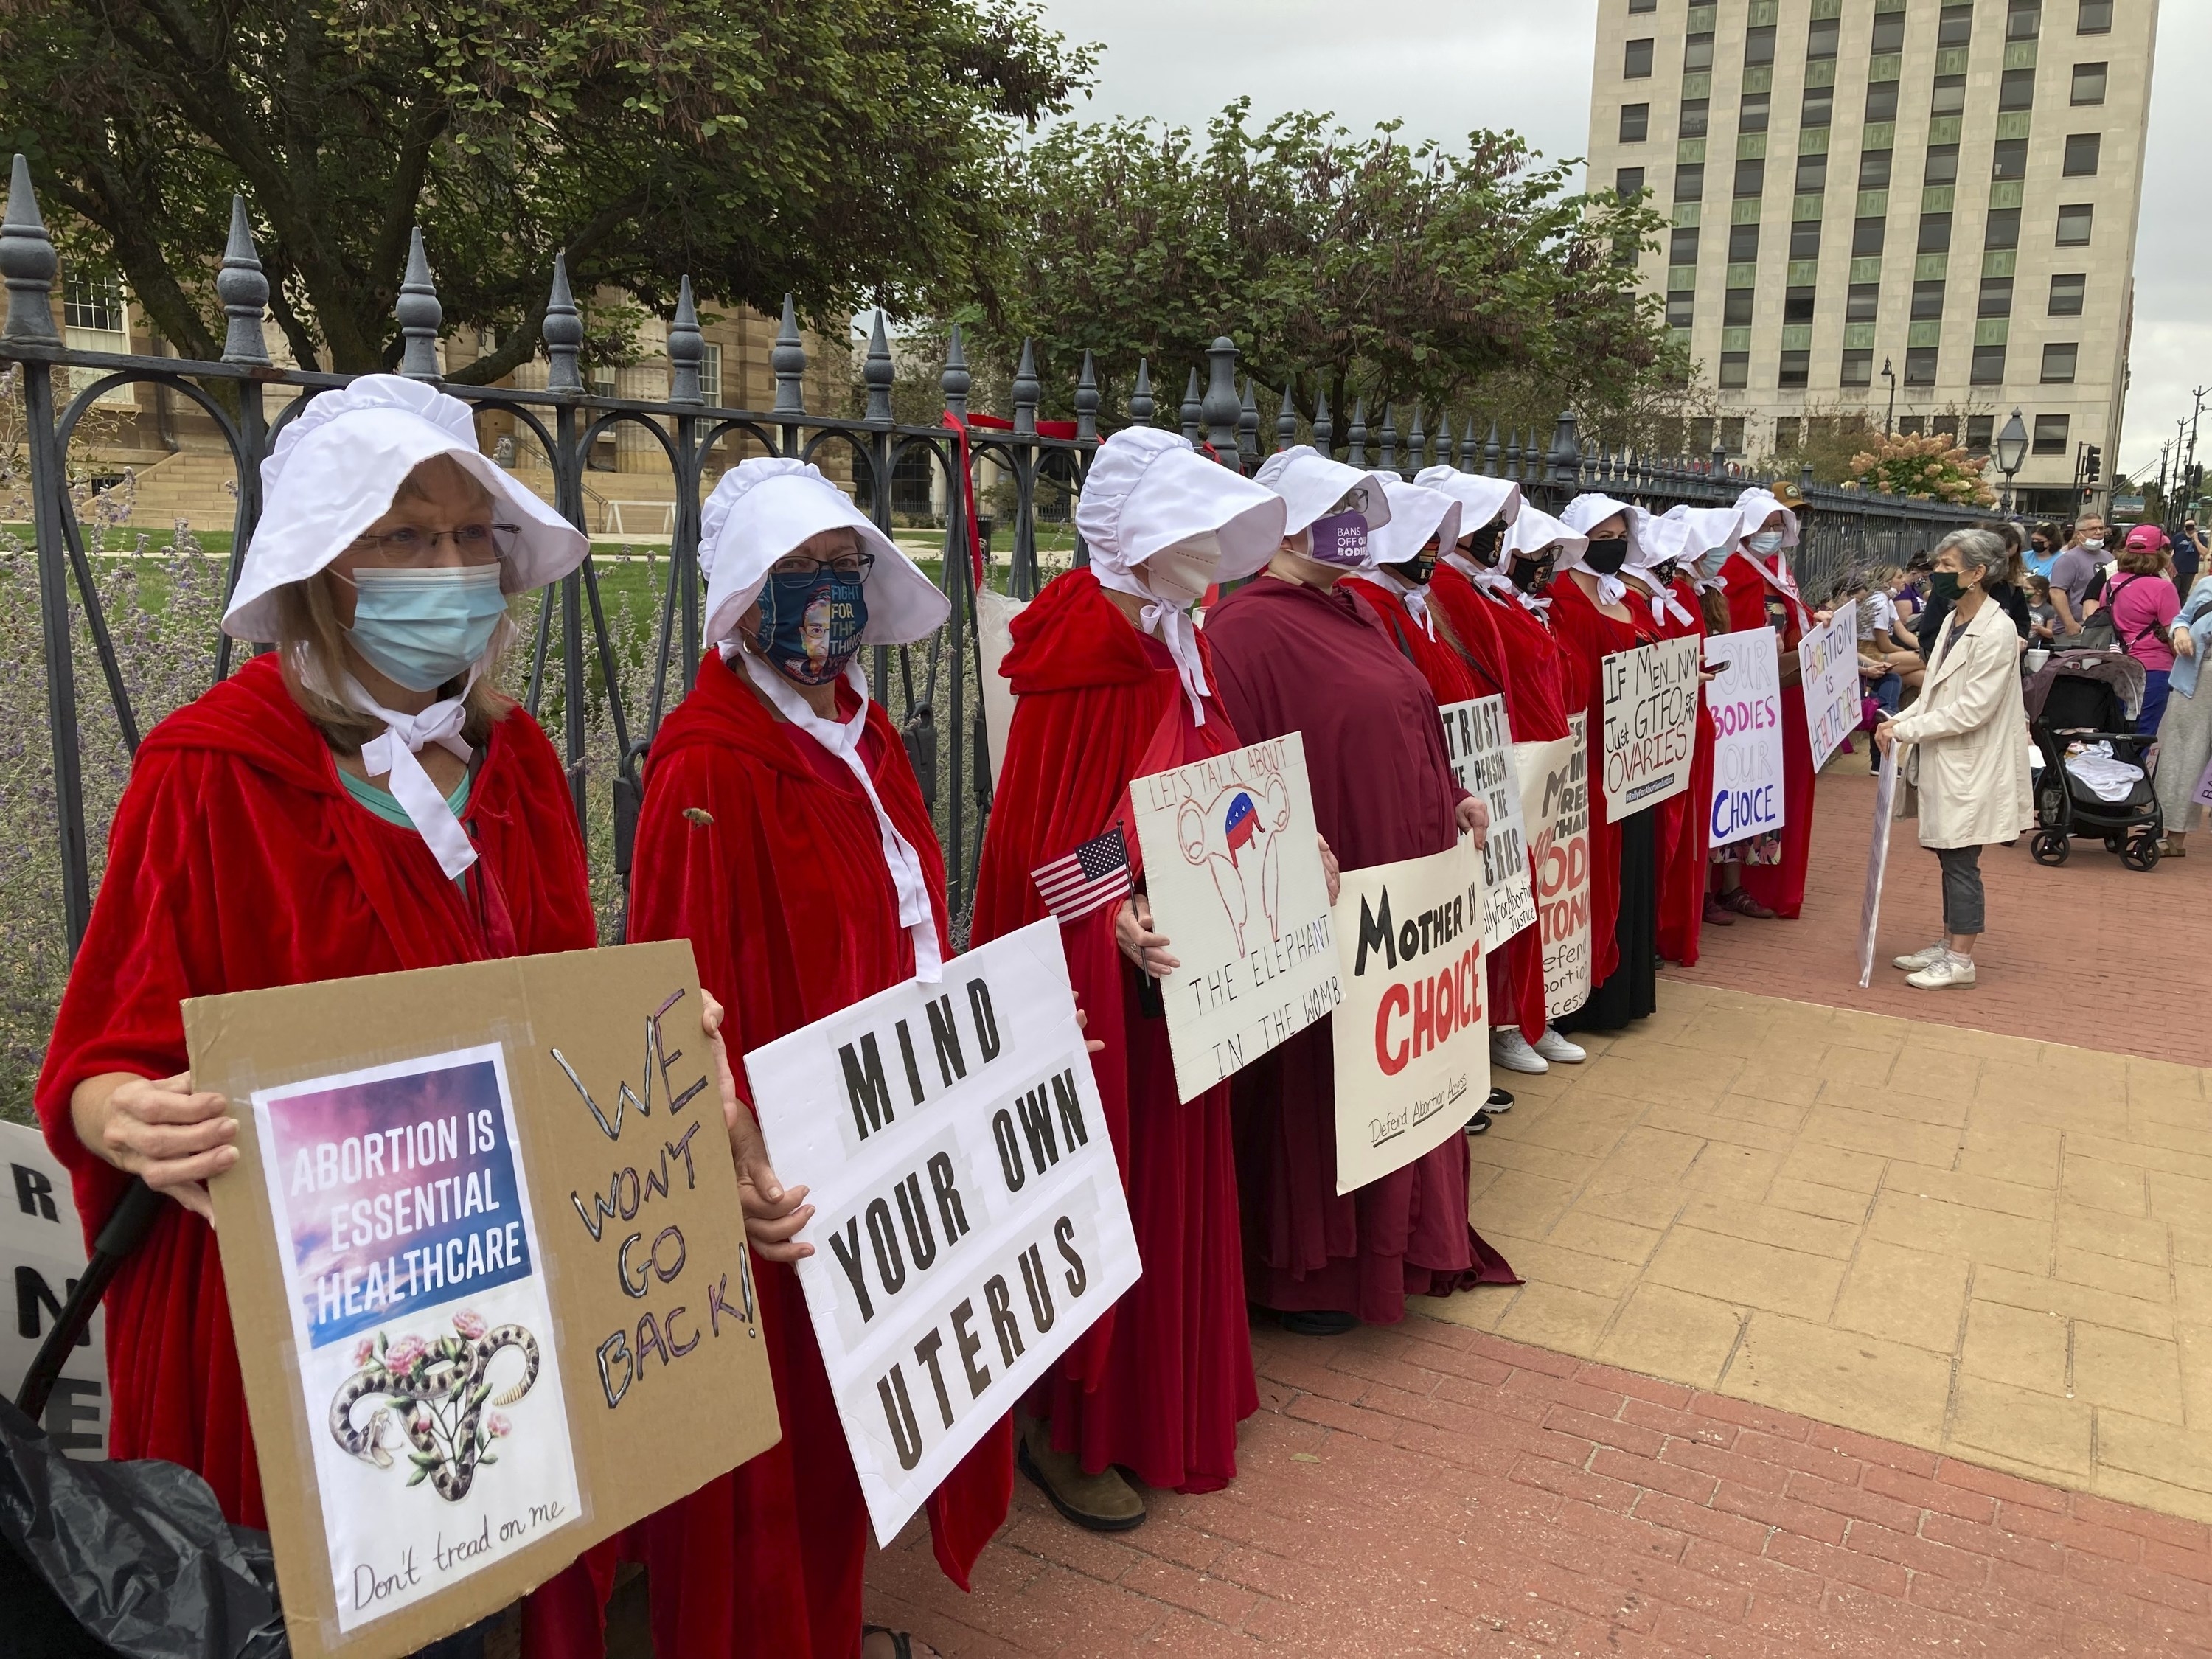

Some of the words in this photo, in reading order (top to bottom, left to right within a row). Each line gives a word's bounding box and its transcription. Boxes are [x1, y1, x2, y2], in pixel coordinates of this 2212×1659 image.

[1337, 526, 1361, 537] BANS
[1337, 537, 1357, 546] OFF
[830, 585, 860, 601] FIGHT
[830, 602, 855, 619] FOR
[1604, 656, 1627, 705] IF
[1719, 640, 1771, 695] OUR
[1804, 614, 1852, 691] ABORTION
[1442, 700, 1501, 761] TRUST
[1635, 686, 1683, 740] GTFO
[1683, 700, 1697, 723] MY
[1685, 691, 1696, 706] OF
[1709, 695, 1775, 741] BODIES
[1810, 678, 1861, 765] HEALTHCARE
[1194, 752, 1245, 792] TALK
[1246, 739, 1287, 779] ABOUT
[1474, 750, 1508, 792] PERSON
[1607, 721, 1687, 794] OVARIES
[1722, 740, 1773, 790] OUR
[1490, 788, 1509, 822] THE
[1711, 784, 1776, 838] CHOICE
[1354, 884, 1464, 977] MOTHER
[1508, 907, 1536, 934] Justice
[1189, 962, 1238, 1016] THE
[1251, 914, 1332, 987] ELEPHANT
[1211, 1033, 1245, 1081] IN
[1258, 1002, 1296, 1050] THE
[1303, 975, 1341, 1023] WOMB
[1374, 938, 1482, 1077] CHOICE
[550, 988, 709, 1141] WE
[838, 978, 1001, 1141] MIND
[1368, 1106, 1408, 1144] Defend
[1412, 1090, 1446, 1124] Abortion
[1447, 1073, 1467, 1101] Access
[291, 1116, 458, 1197] ABORTION
[467, 1109, 495, 1155] IS
[330, 1168, 500, 1253] ESSENTIAL
[827, 1150, 971, 1325] YOUR
[992, 1067, 1090, 1194] OWN
[317, 1221, 521, 1325] HEALTHCARE
[618, 1225, 686, 1299] GO
[596, 1242, 756, 1410] BACK!
[876, 1214, 1088, 1472] UTERUS
[354, 1545, 421, 1610] Don't
[433, 1514, 493, 1571] tread
[499, 1519, 526, 1542] on
[528, 1500, 565, 1527] me
